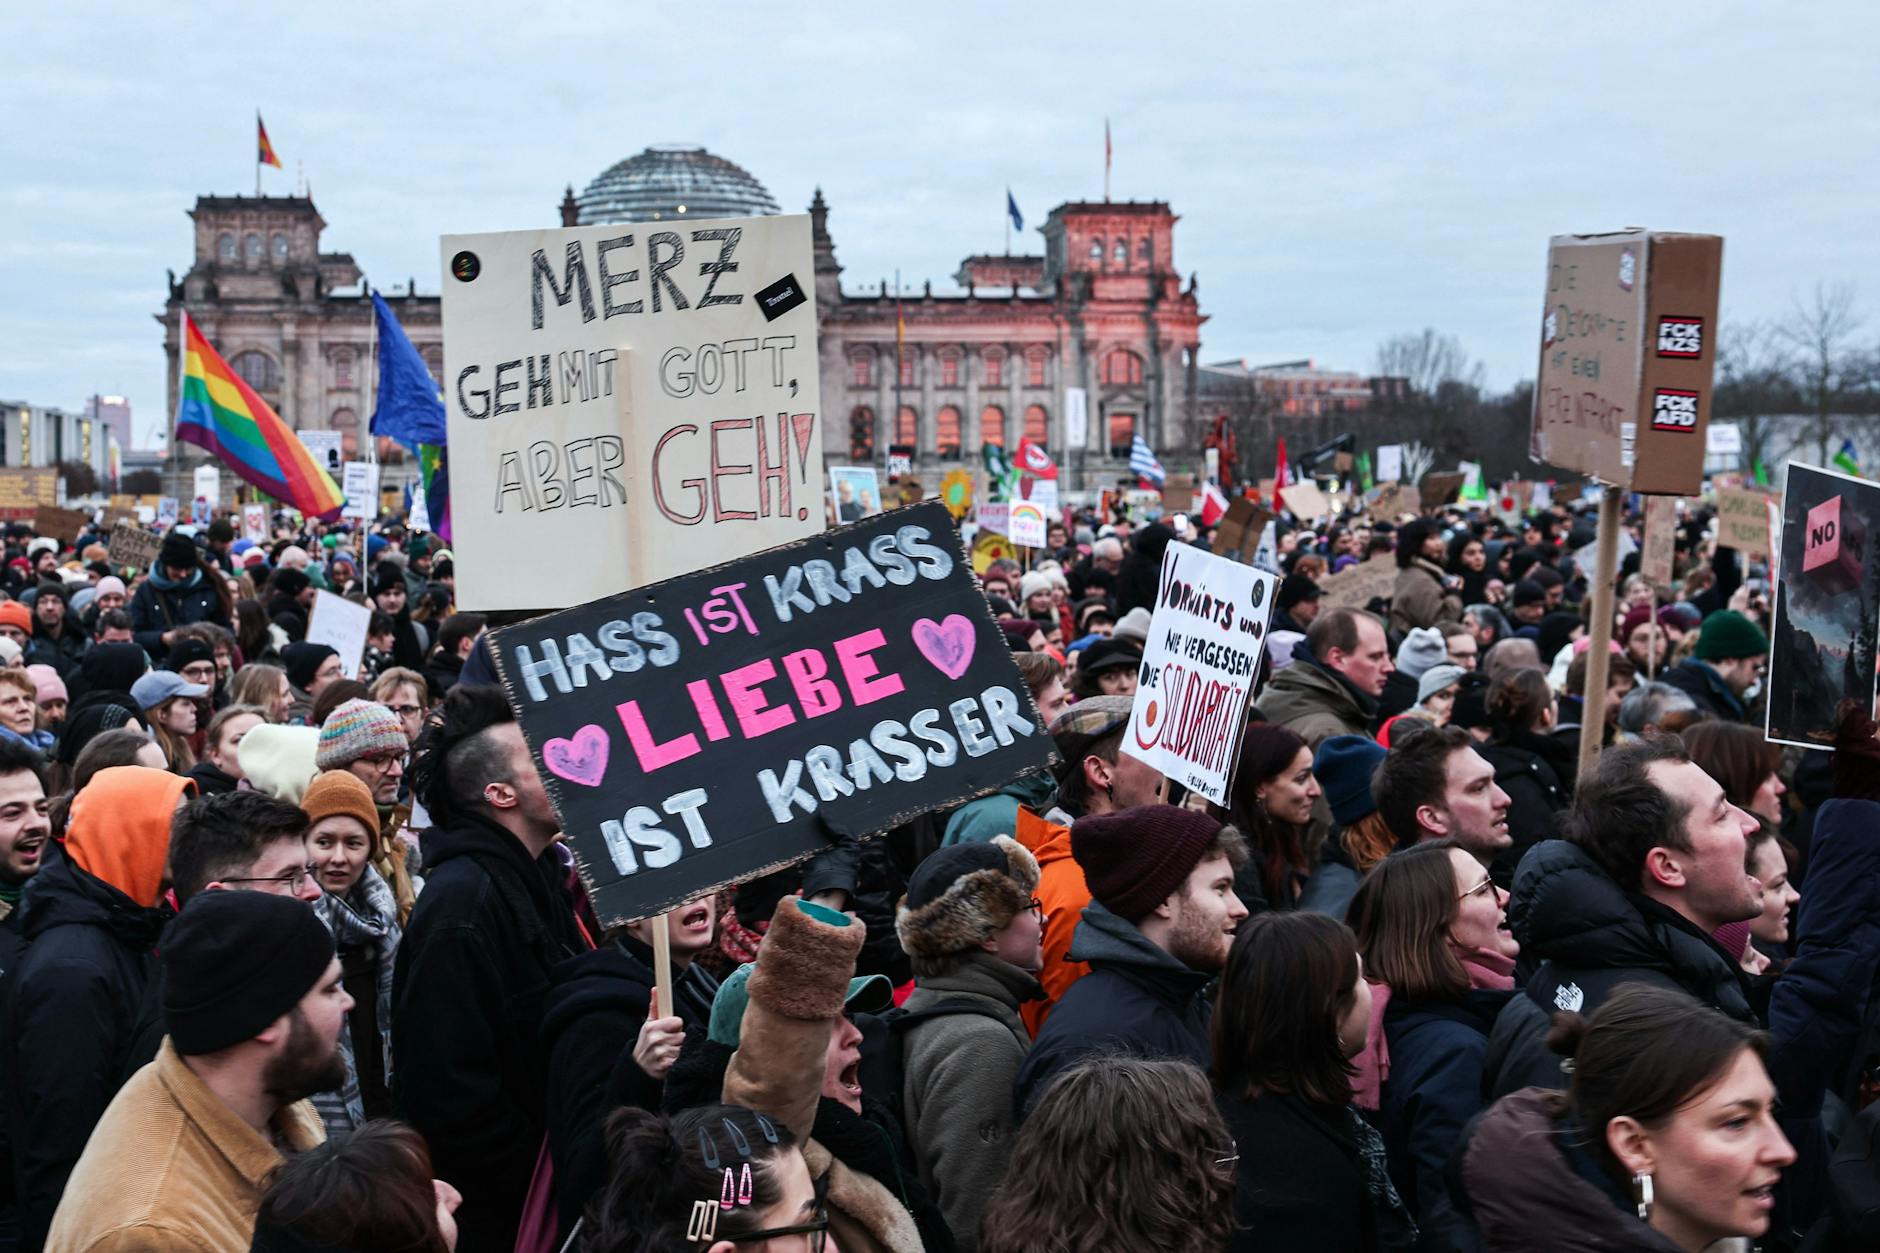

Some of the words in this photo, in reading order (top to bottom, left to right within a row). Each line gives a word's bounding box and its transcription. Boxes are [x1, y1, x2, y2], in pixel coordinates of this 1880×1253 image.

[532, 227, 744, 330] MERZ
[1658, 336, 1701, 352] NZS
[1660, 322, 1701, 338] FCK
[457, 353, 554, 420] GEH
[558, 348, 618, 405] MIT
[659, 335, 799, 399] GOTT,
[1653, 409, 1697, 427] AFD
[1655, 394, 1697, 412] FCK
[494, 434, 628, 514] ABER
[652, 412, 816, 526] GEH!
[1811, 520, 1836, 550] NO
[514, 611, 681, 702] HASS
[683, 582, 760, 646] IST
[763, 524, 954, 622] KRASS
[1164, 628, 1182, 654] NIE
[1140, 660, 1161, 689] DIE
[616, 628, 906, 773] LIEBE
[600, 788, 714, 876] IST
[757, 685, 1035, 823] KRASSER
